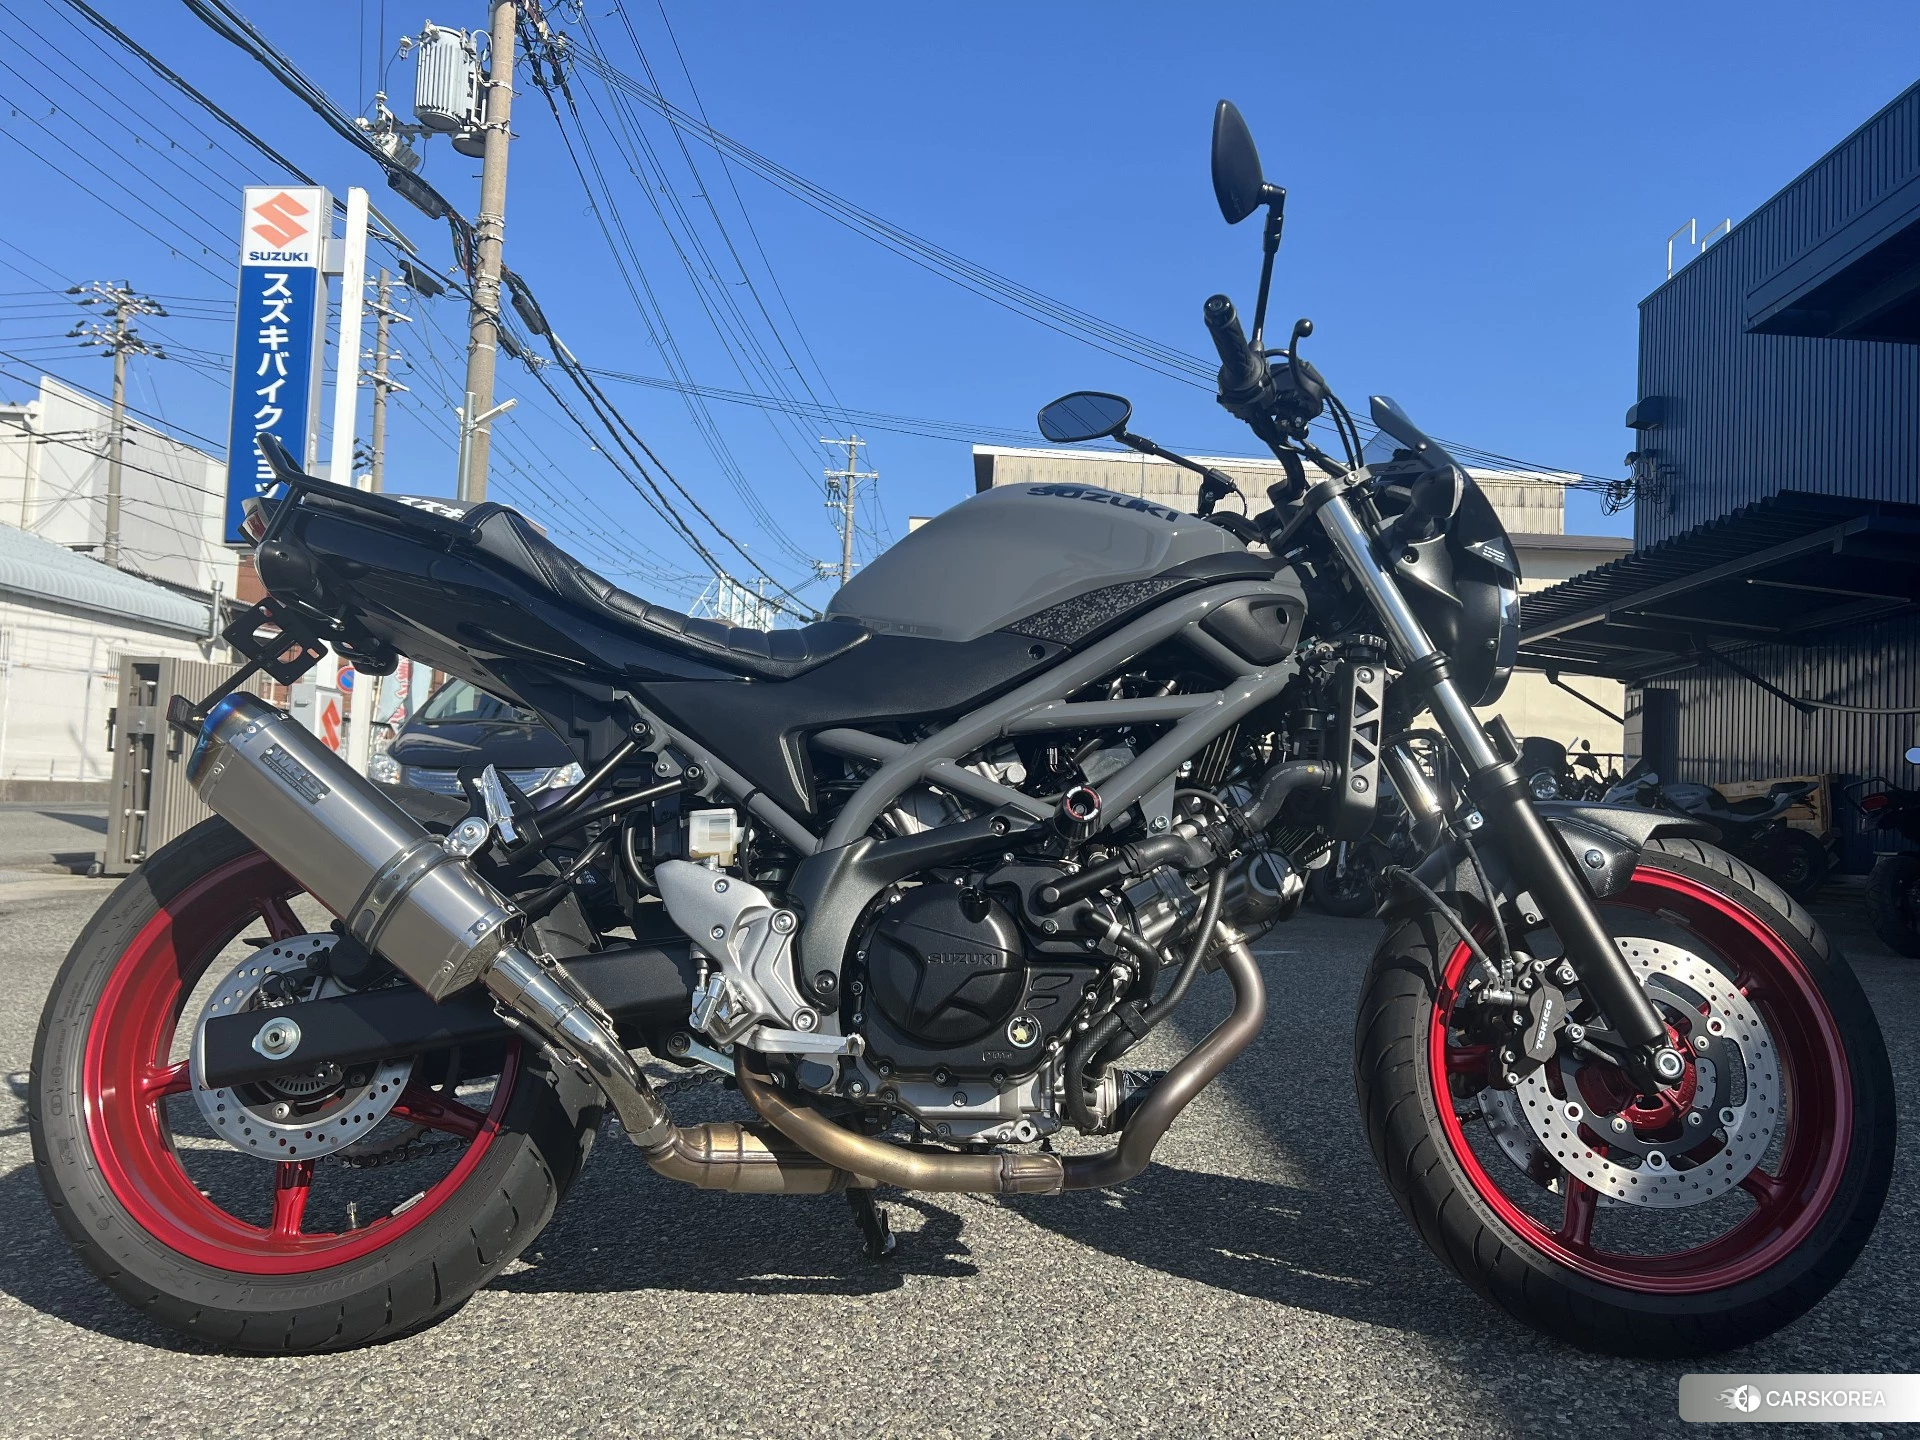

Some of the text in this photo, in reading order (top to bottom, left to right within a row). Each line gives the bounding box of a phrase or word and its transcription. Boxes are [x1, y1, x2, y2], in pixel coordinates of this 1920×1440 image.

[249, 251, 308, 262] SUZUKI
[1027, 485, 1180, 522] SUZUKI
[928, 952, 998, 966] SUZUKI
[1536, 999, 1553, 1049] TOKICO
